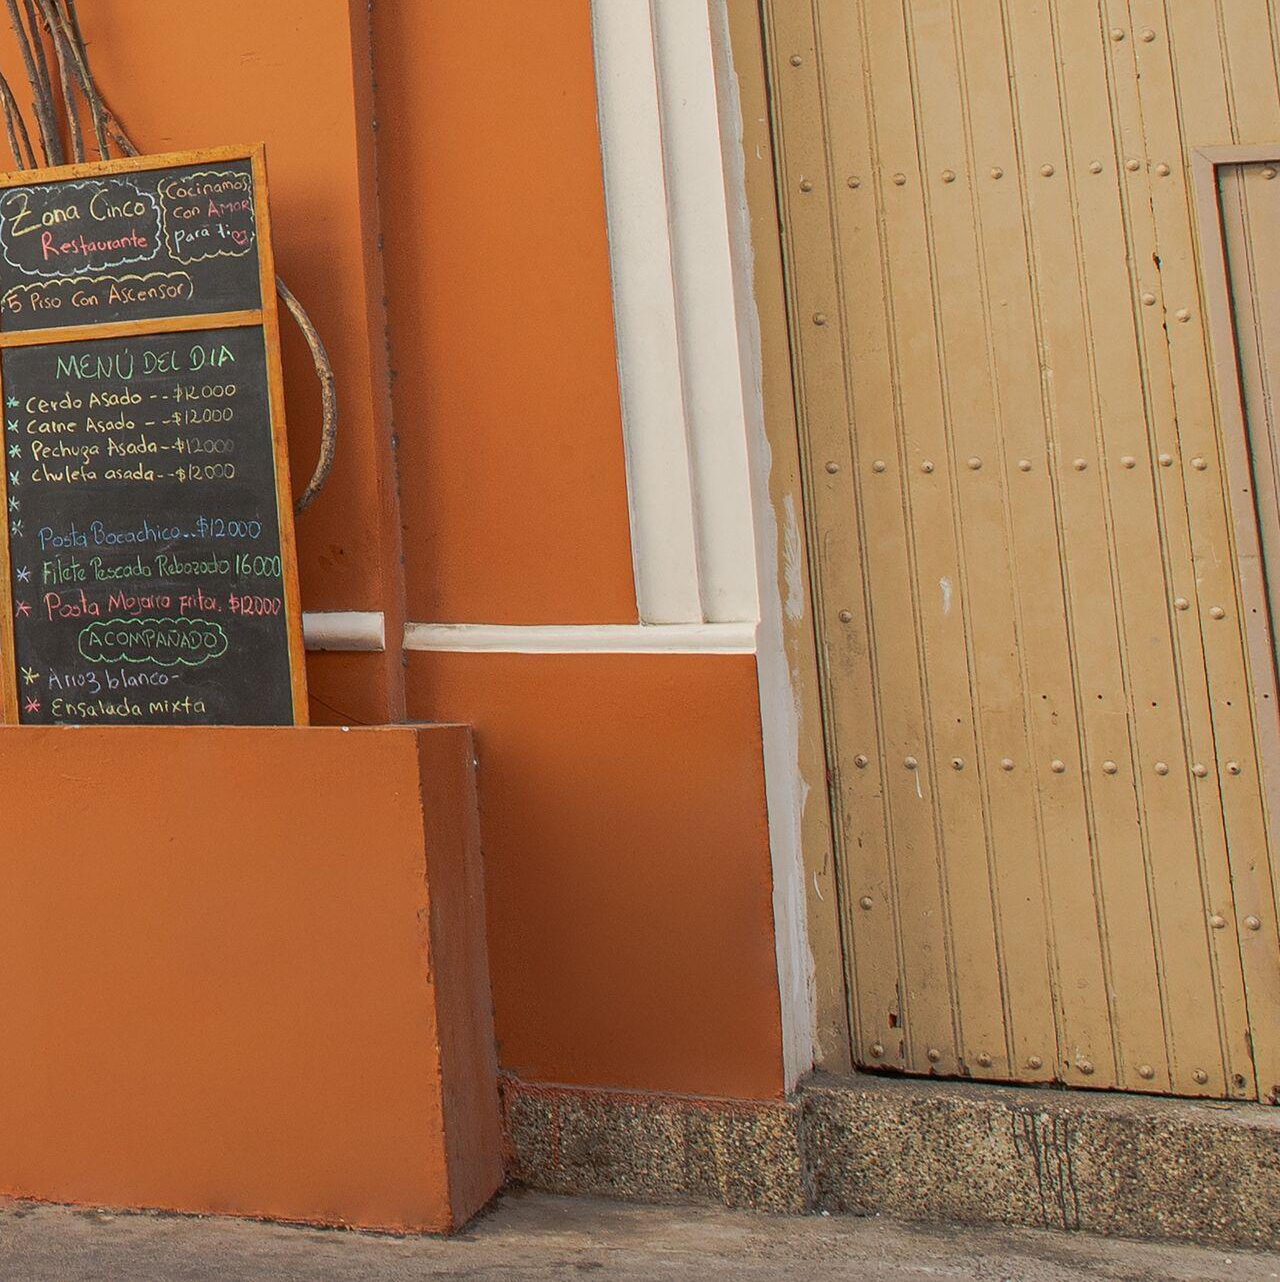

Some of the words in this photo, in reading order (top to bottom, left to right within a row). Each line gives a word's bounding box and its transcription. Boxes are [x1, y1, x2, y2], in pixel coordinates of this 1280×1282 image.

[165, 177, 248, 199] Cocinamos
[6, 193, 81, 237] Zona
[90, 188, 146, 221] Cinco
[41, 228, 148, 261] Restaurante
[7, 293, 22, 314] 5
[30, 291, 62, 312] Piso
[108, 281, 185, 305] Ascensor
[143, 350, 180, 375] DEL
[190, 344, 235, 367] DIA
[31, 440, 100, 465] Pechuga
[107, 434, 158, 457] Asada
[38, 522, 89, 551] Posta
[41, 556, 87, 585] Filete
[90, 555, 153, 581] Pescado
[43, 588, 101, 622] Posta
[89, 628, 219, 651] ACOMPAÑADO
[48, 668, 102, 695] Arroz
[51, 697, 143, 718] Ensalada
[149, 696, 206, 715] mixta
